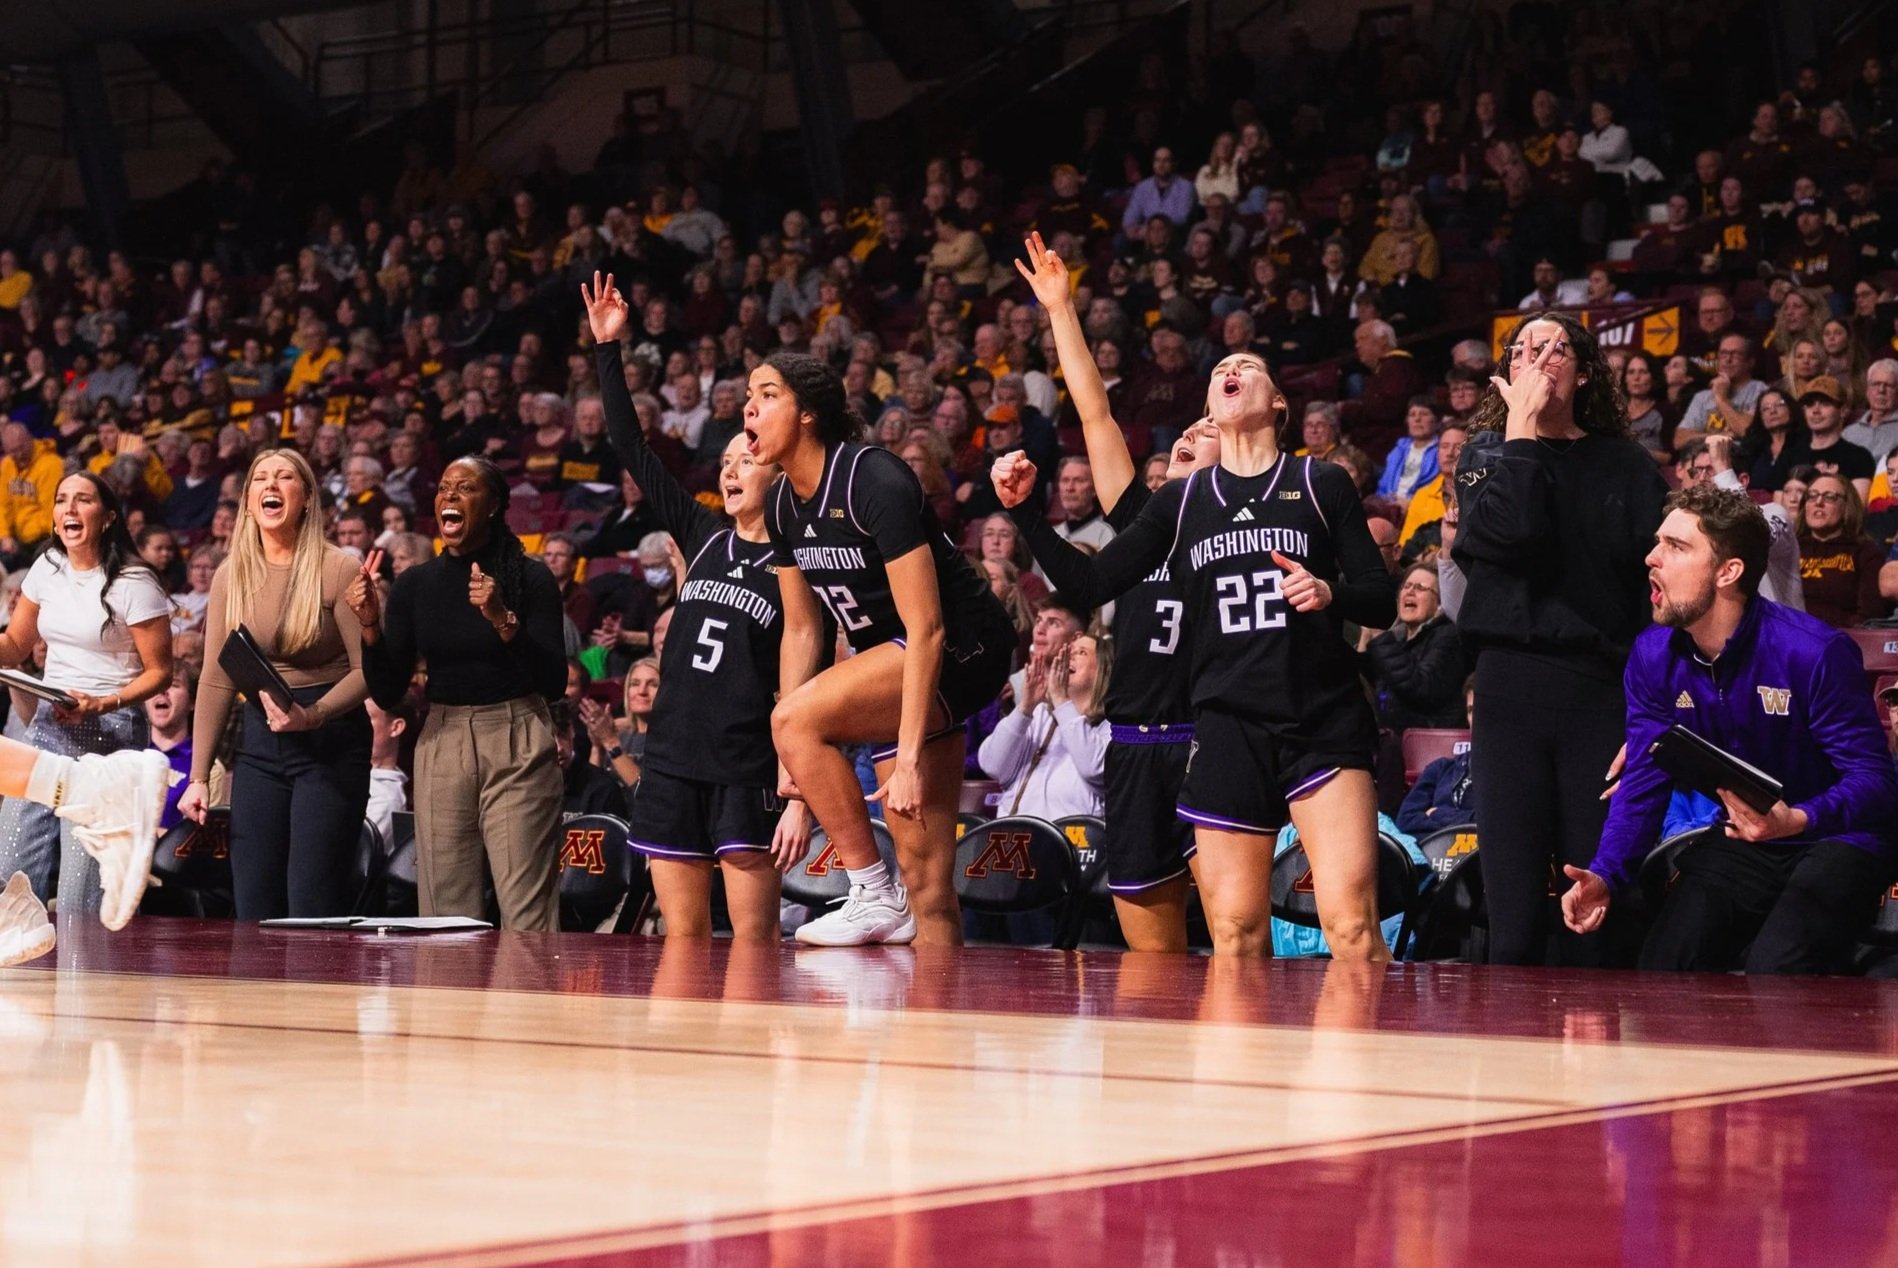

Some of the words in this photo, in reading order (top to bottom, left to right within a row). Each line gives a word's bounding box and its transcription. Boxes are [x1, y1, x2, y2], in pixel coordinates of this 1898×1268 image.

[793, 547, 867, 570] SHINGTON
[1190, 527, 1308, 571] WASHINGTON
[680, 579, 777, 629] WASHINGTON
[1216, 570, 1287, 634] 22
[692, 617, 729, 673] 5
[1149, 600, 1183, 654] 3
[1757, 685, 1792, 715] W
[965, 832, 1036, 879] M
